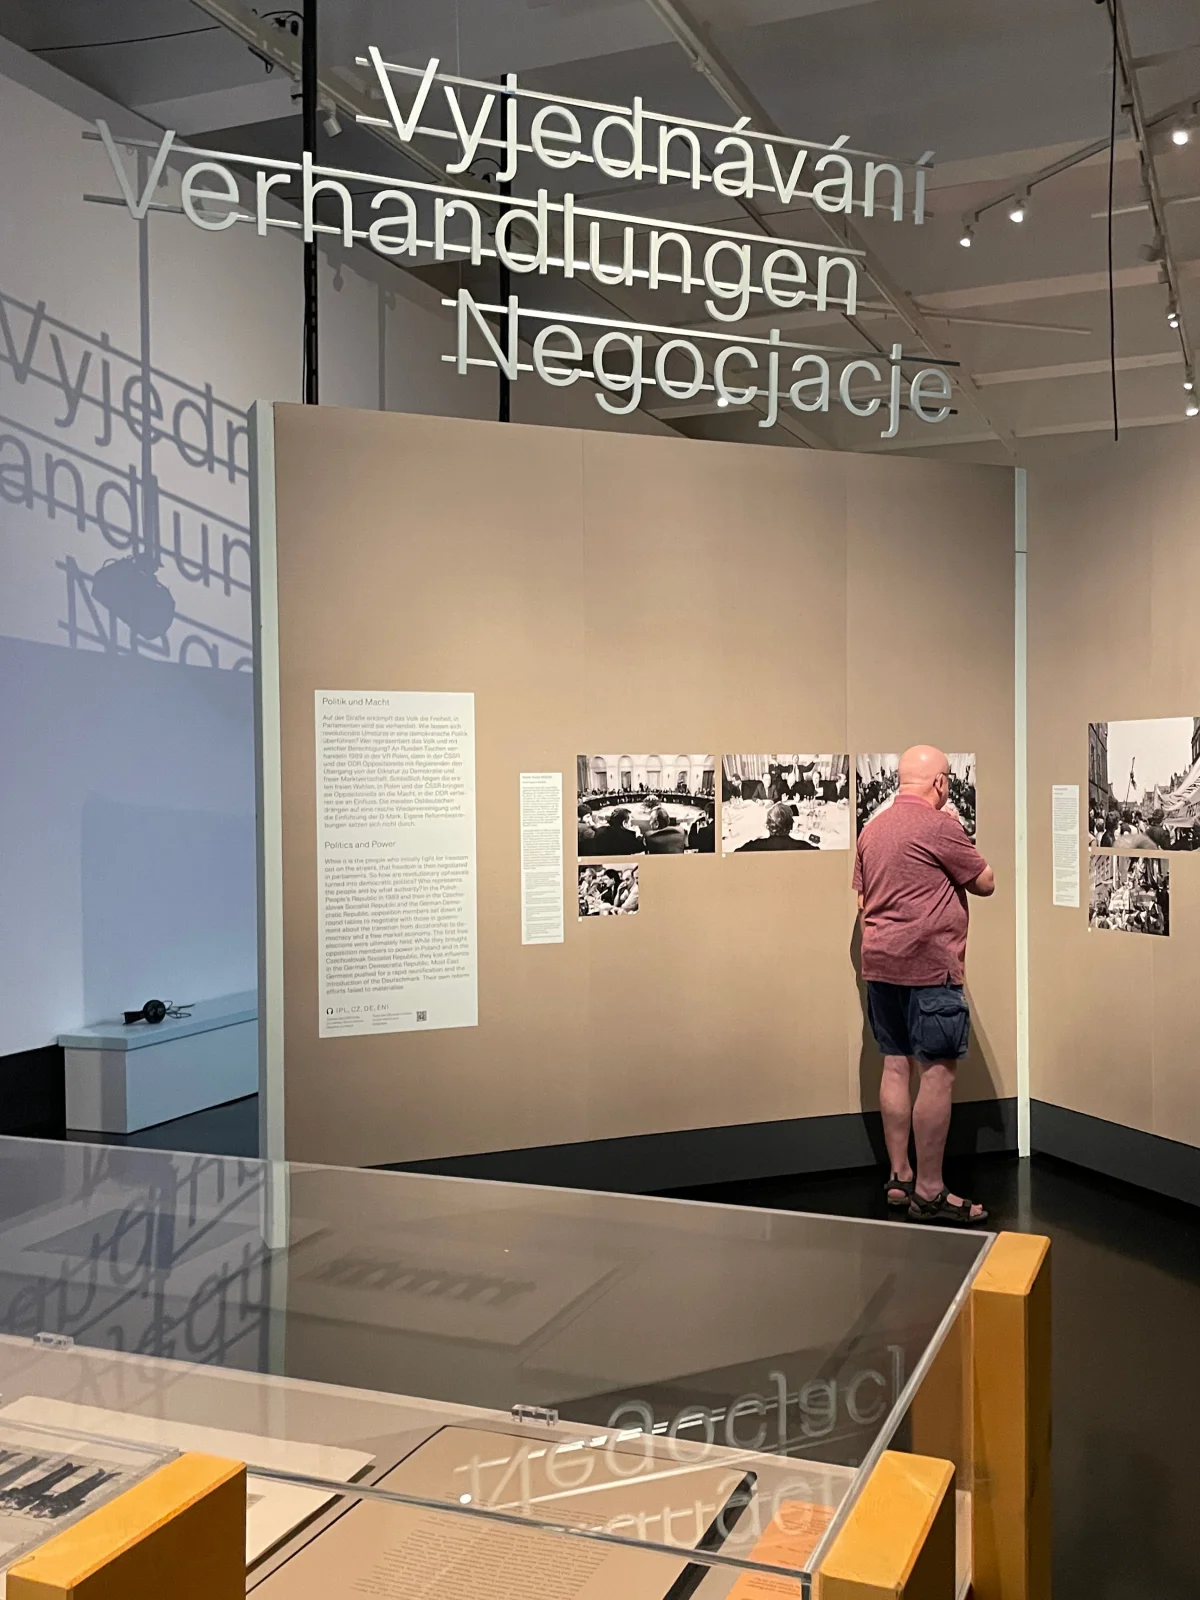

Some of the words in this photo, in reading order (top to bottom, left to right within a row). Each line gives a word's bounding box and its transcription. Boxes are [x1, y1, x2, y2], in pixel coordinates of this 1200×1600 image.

[367, 45, 935, 225] Vyjednávání
[95, 118, 858, 322] Verhandlungen
[456, 288, 953, 439] Negocjacje
[322, 697, 347, 706] Politik
[348, 698, 363, 706] und
[365, 698, 390, 706] Macht
[324, 841, 353, 849] Politics
[354, 840, 369, 849] and
[371, 840, 396, 848] Power
